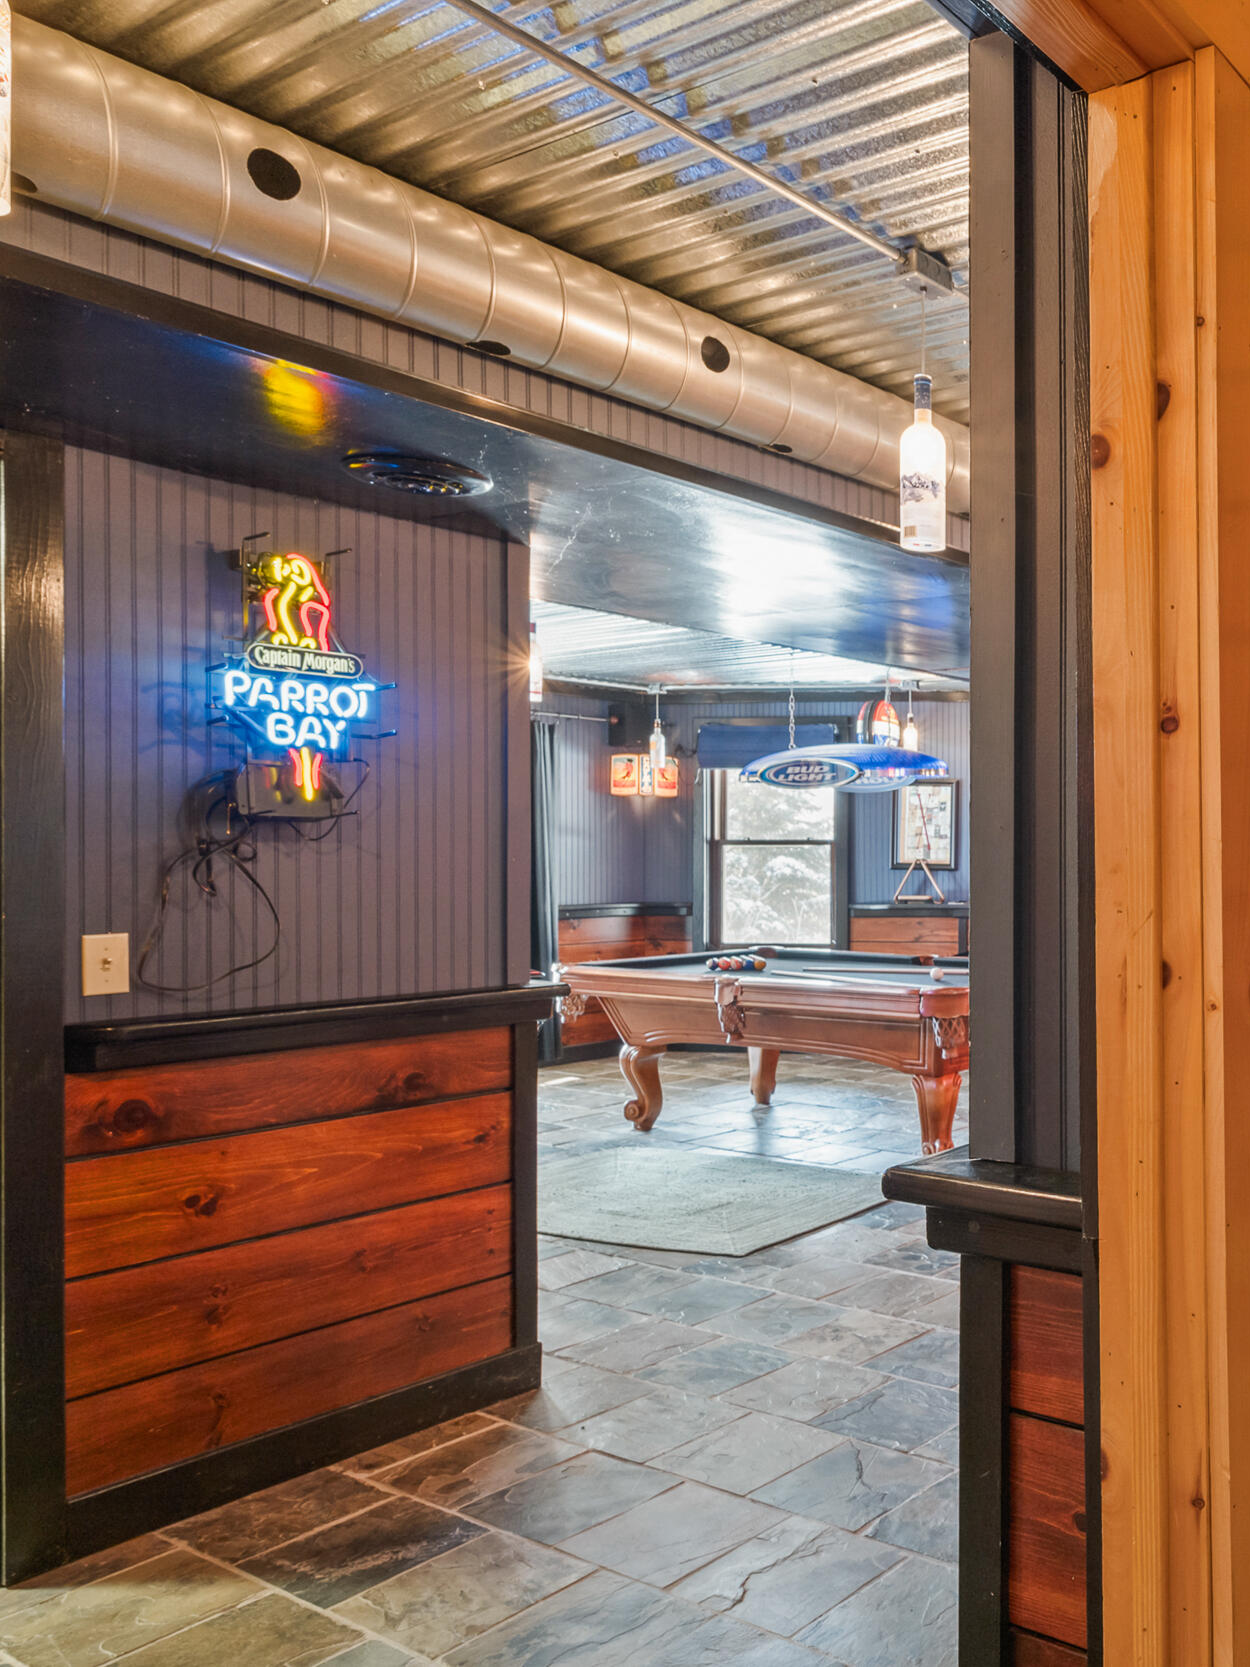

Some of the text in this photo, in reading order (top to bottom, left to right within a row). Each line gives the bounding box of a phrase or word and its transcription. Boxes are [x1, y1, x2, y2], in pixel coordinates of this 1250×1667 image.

[254, 646, 355, 674] Captain Morgan's
[224, 670, 376, 718] PARROT
[267, 712, 347, 749] BAY
[777, 773, 836, 781] LIGHT
[786, 766, 829, 774] BUD
